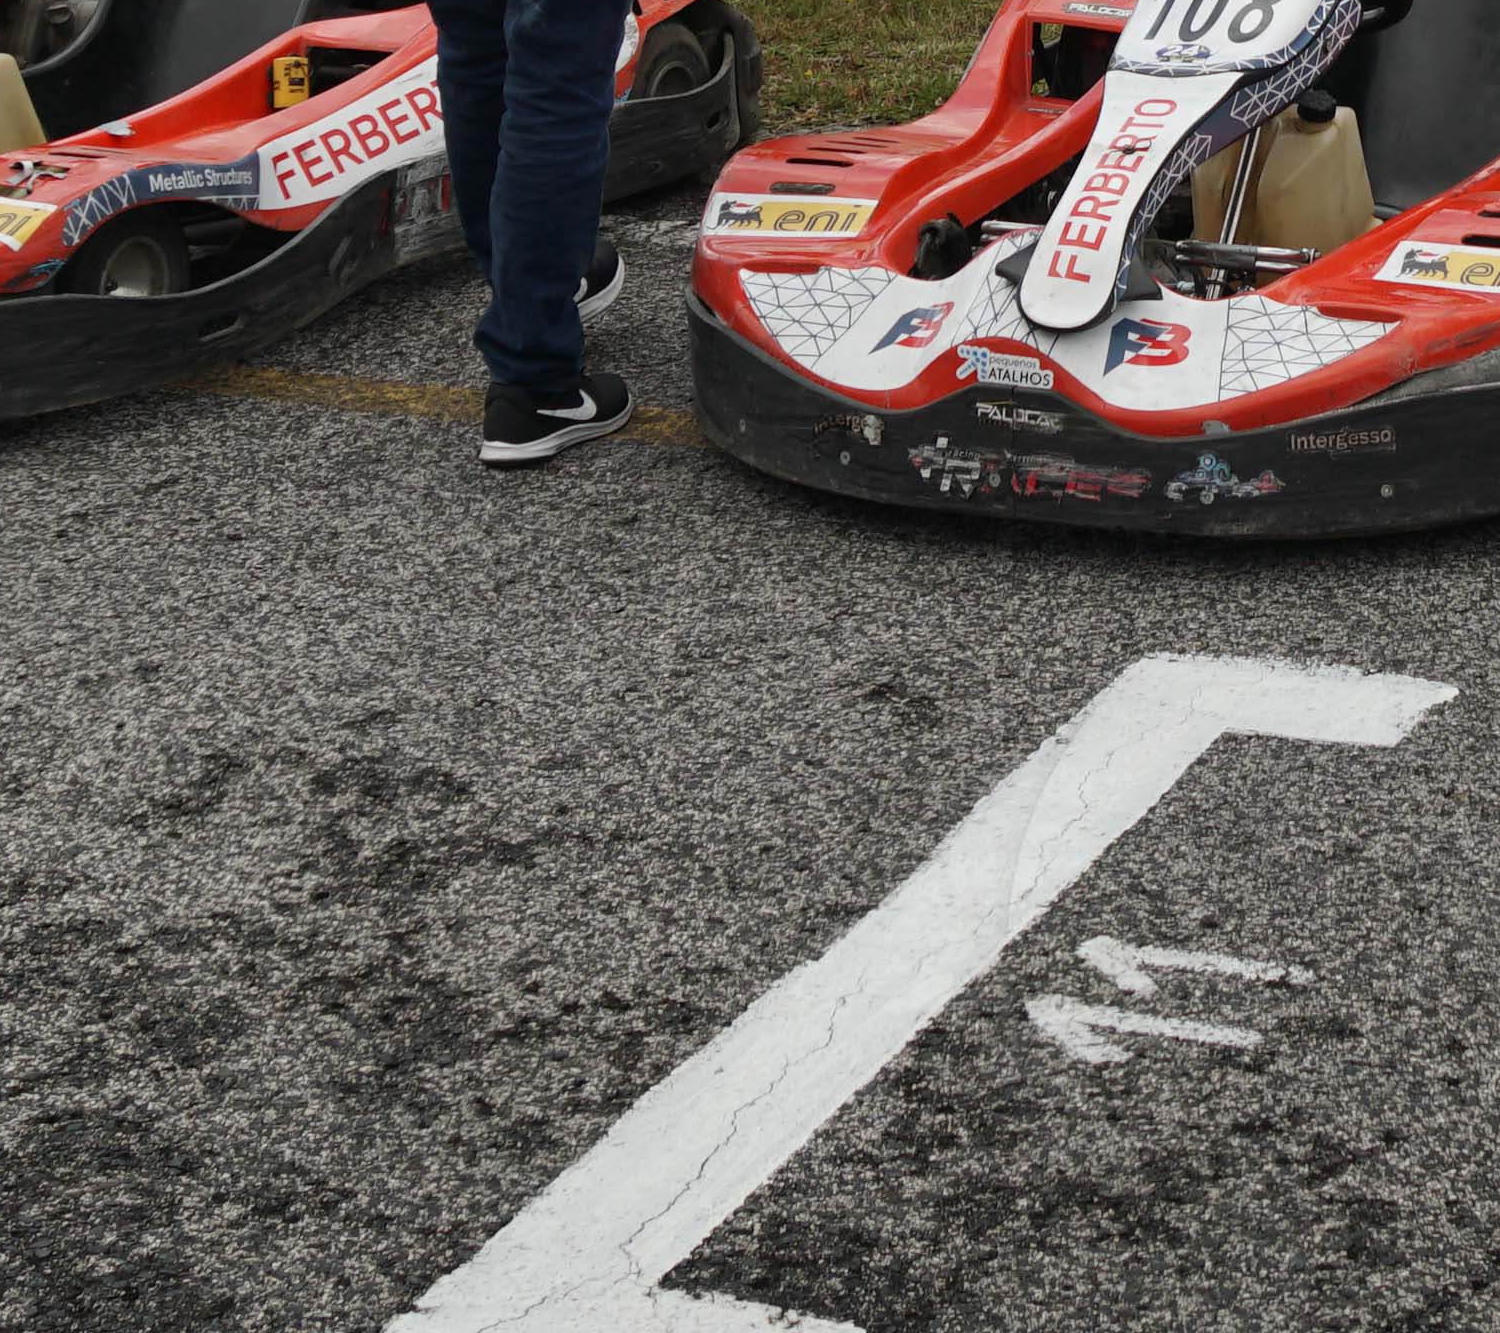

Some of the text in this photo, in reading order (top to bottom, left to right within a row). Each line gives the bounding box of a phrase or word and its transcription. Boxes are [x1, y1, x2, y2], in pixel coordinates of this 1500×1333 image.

[148, 164, 253, 193] Metallic Structures
[1047, 98, 1178, 283] FERBERTO
[773, 204, 864, 232] eni
[988, 366, 1050, 387] ATALHOS
[1290, 428, 1393, 451] Intergesso
